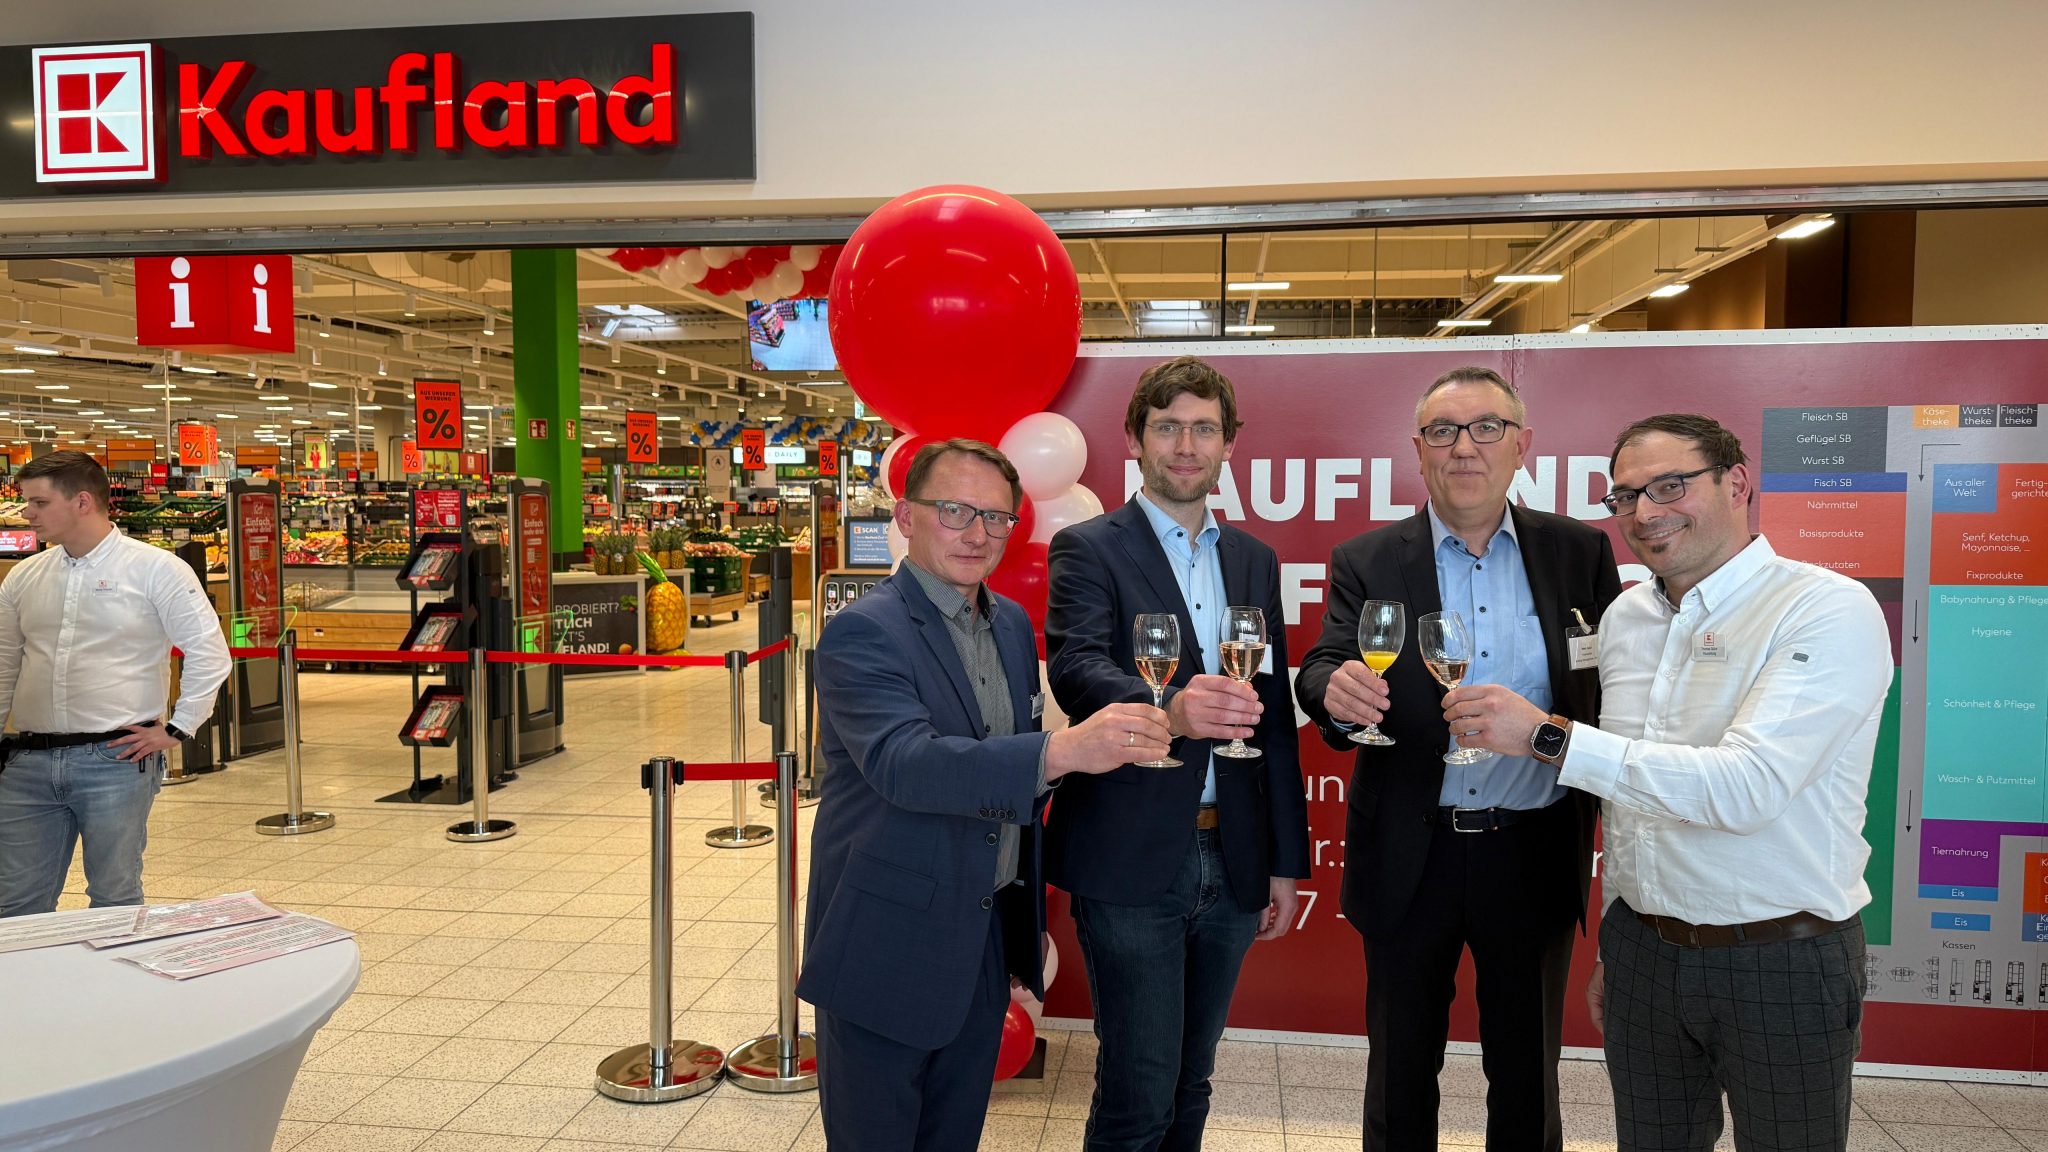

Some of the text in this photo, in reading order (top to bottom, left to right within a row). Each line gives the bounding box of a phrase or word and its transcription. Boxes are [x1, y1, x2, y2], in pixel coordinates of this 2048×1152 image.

[179, 43, 677, 158] Kaufland
[1923, 407, 1950, 415] Käse-
[1962, 406, 1995, 415] Wurst-
[2000, 406, 2038, 415] Fleisch-
[1802, 412, 1848, 421] Fleisch SB
[1922, 417, 1950, 425] theke
[1964, 417, 1992, 425] theke
[2004, 417, 2032, 425] theke
[1796, 434, 1852, 445] Geflügel SB
[1802, 456, 1845, 465] Wurst SB
[1814, 478, 1852, 487] Fisch SB
[1944, 478, 1986, 487] Aus aller
[2015, 478, 2048, 489] Fertig-
[1125, 456, 1614, 521] AUFLND
[1953, 488, 1977, 497] Welt
[1807, 500, 1858, 509] Nährmittel
[1799, 528, 1864, 539] Basisprodukte
[1962, 532, 2031, 543] Senf, Ketchup,
[1961, 543, 2022, 554] Mayonnaise,
[1966, 570, 2024, 581] Fixprodukte
[1940, 594, 2048, 607] Babynahrung & Pflege
[555, 602, 620, 616] PROBIERT?
[1971, 627, 2013, 638] Hygiene
[1943, 698, 2036, 711] Schönheit & Pflege
[1937, 774, 2036, 785] Wasch- & Putzmittel
[1931, 846, 1989, 859] Tiernahrung
[1951, 888, 1965, 897] Eis
[1954, 917, 1968, 926] Eis
[1942, 940, 1976, 950] Kassen
